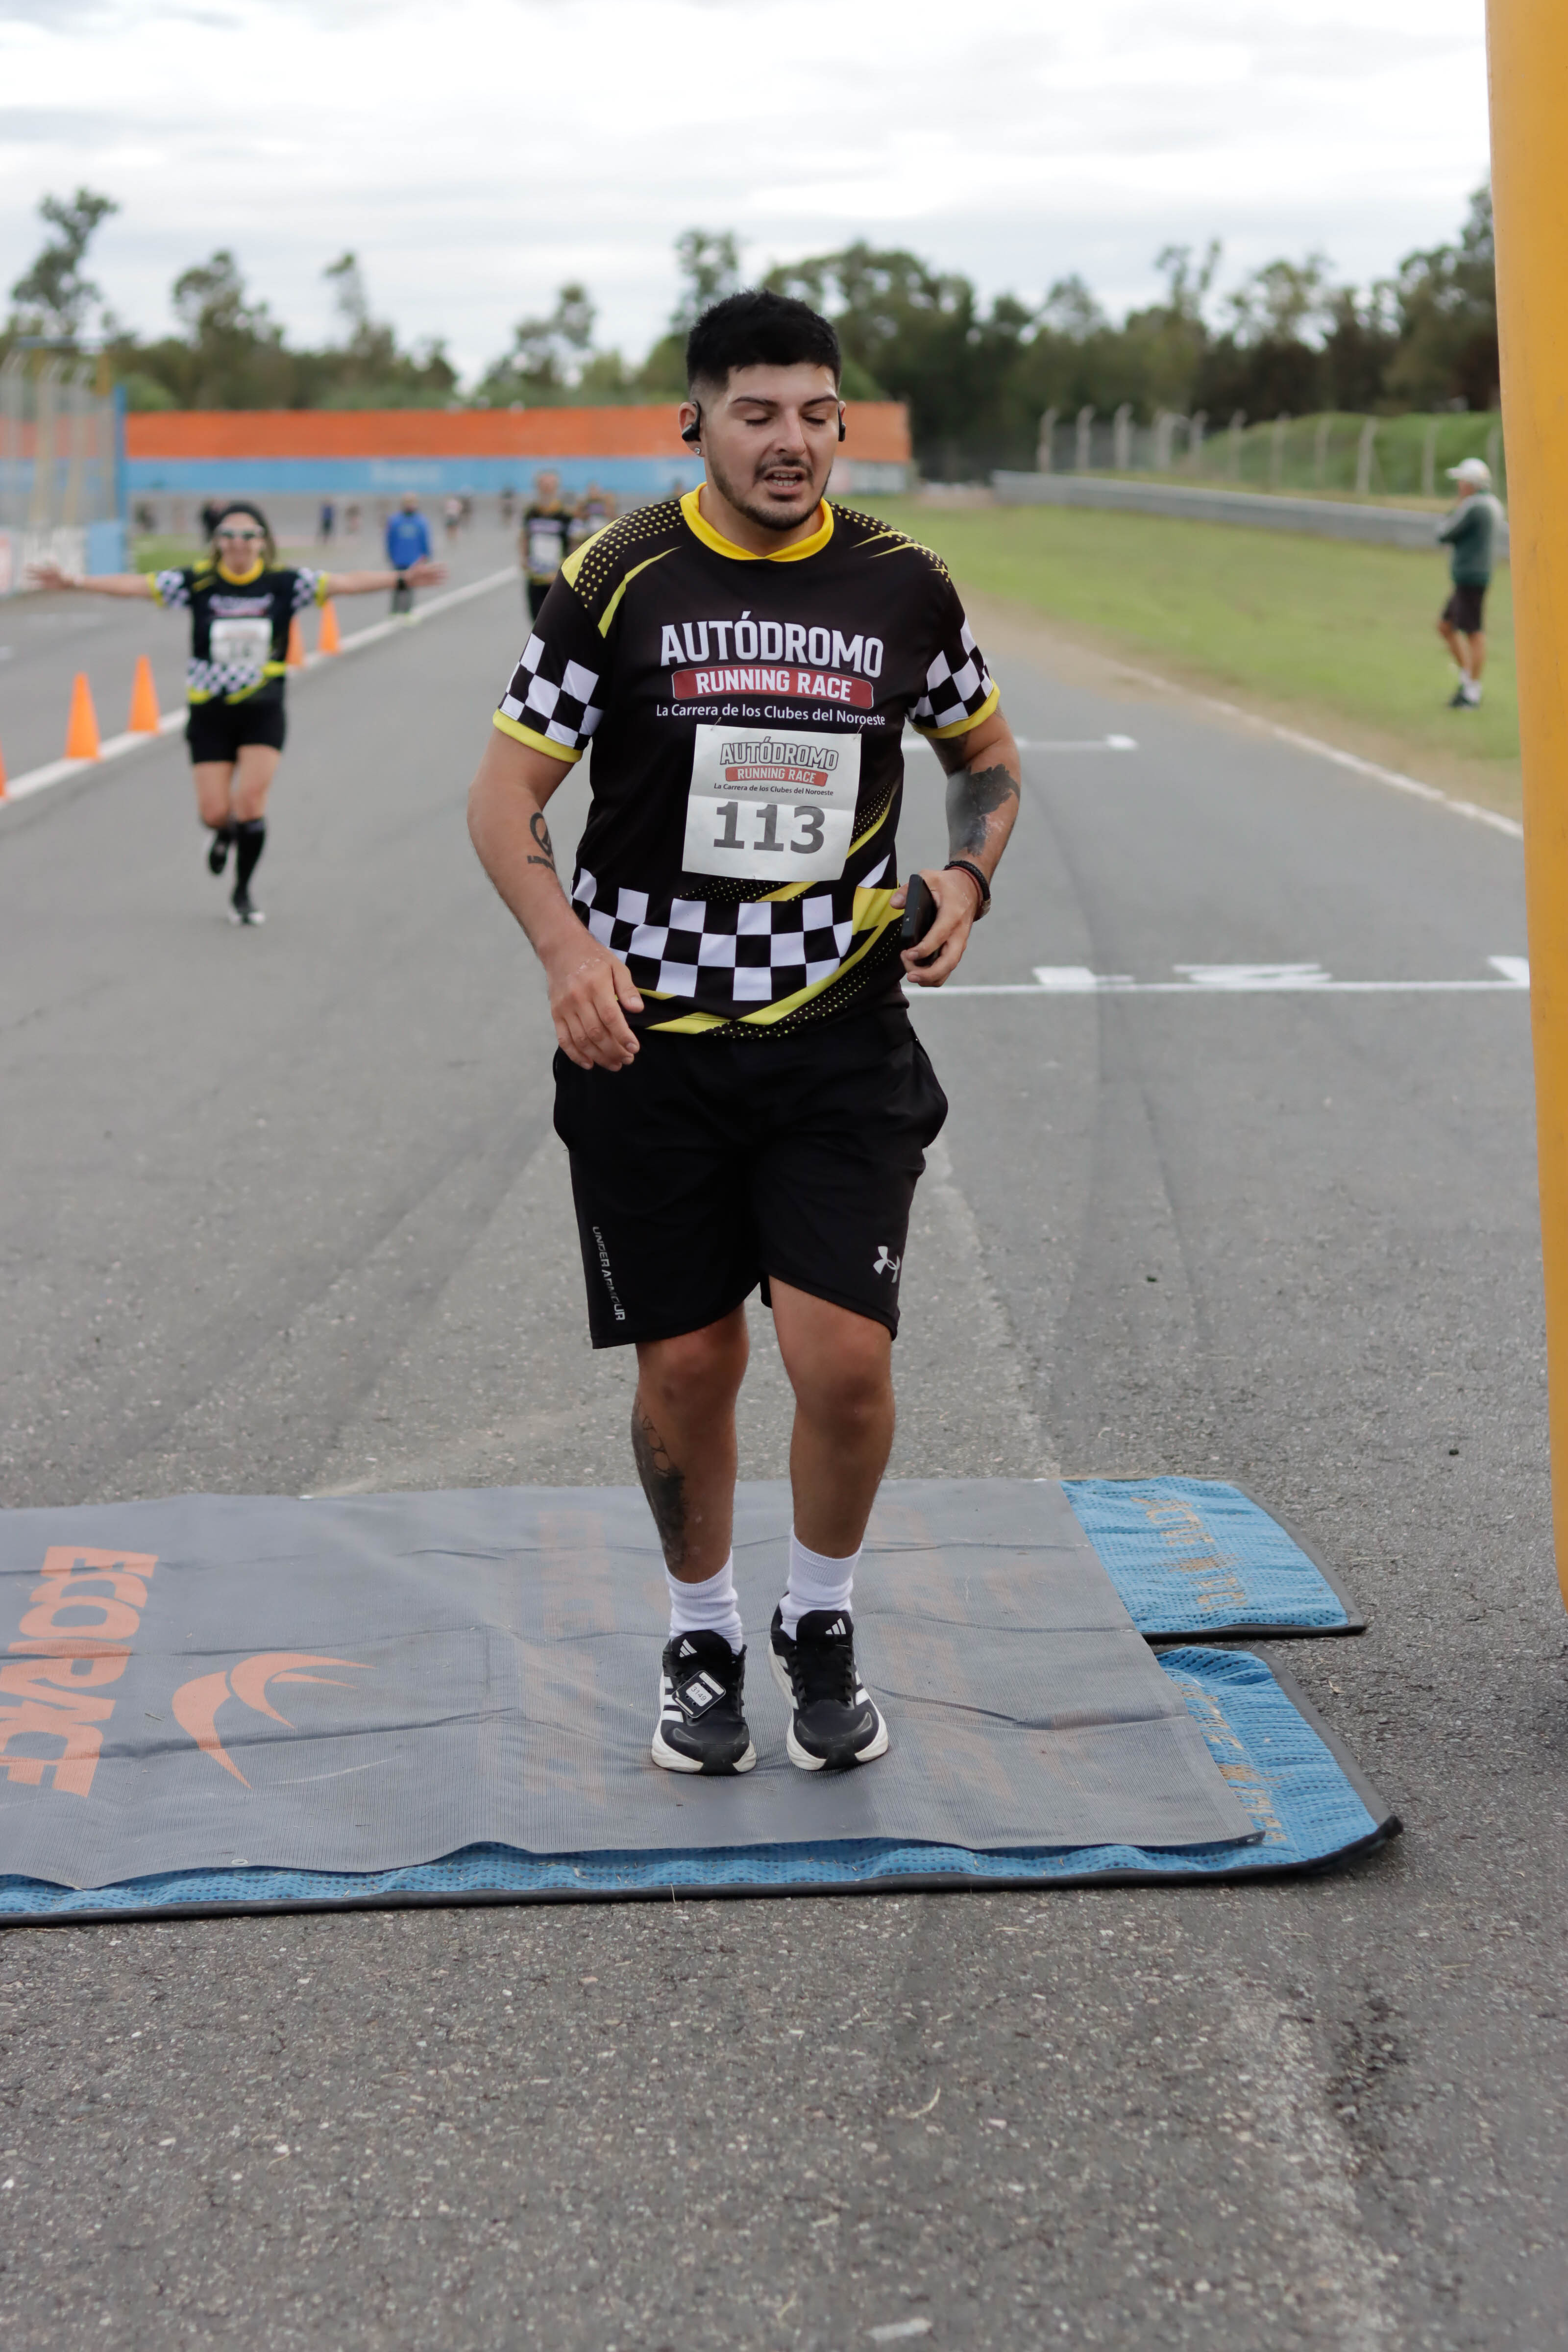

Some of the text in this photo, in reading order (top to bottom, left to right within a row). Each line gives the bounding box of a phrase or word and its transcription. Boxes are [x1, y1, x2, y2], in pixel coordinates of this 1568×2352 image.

[660, 610, 883, 678] AUTÓDROMO
[695, 670, 853, 702] RUNNING RACE
[656, 703, 886, 726] La Carrera de los Clubes del Noroeste
[719, 736, 839, 771] AUTÓDROMO
[737, 767, 816, 784] RUNNING RACE
[713, 801, 826, 855] 113
[592, 1226, 626, 1321] UNDER ARMOUR
[691, 1686, 707, 1701] 3149
